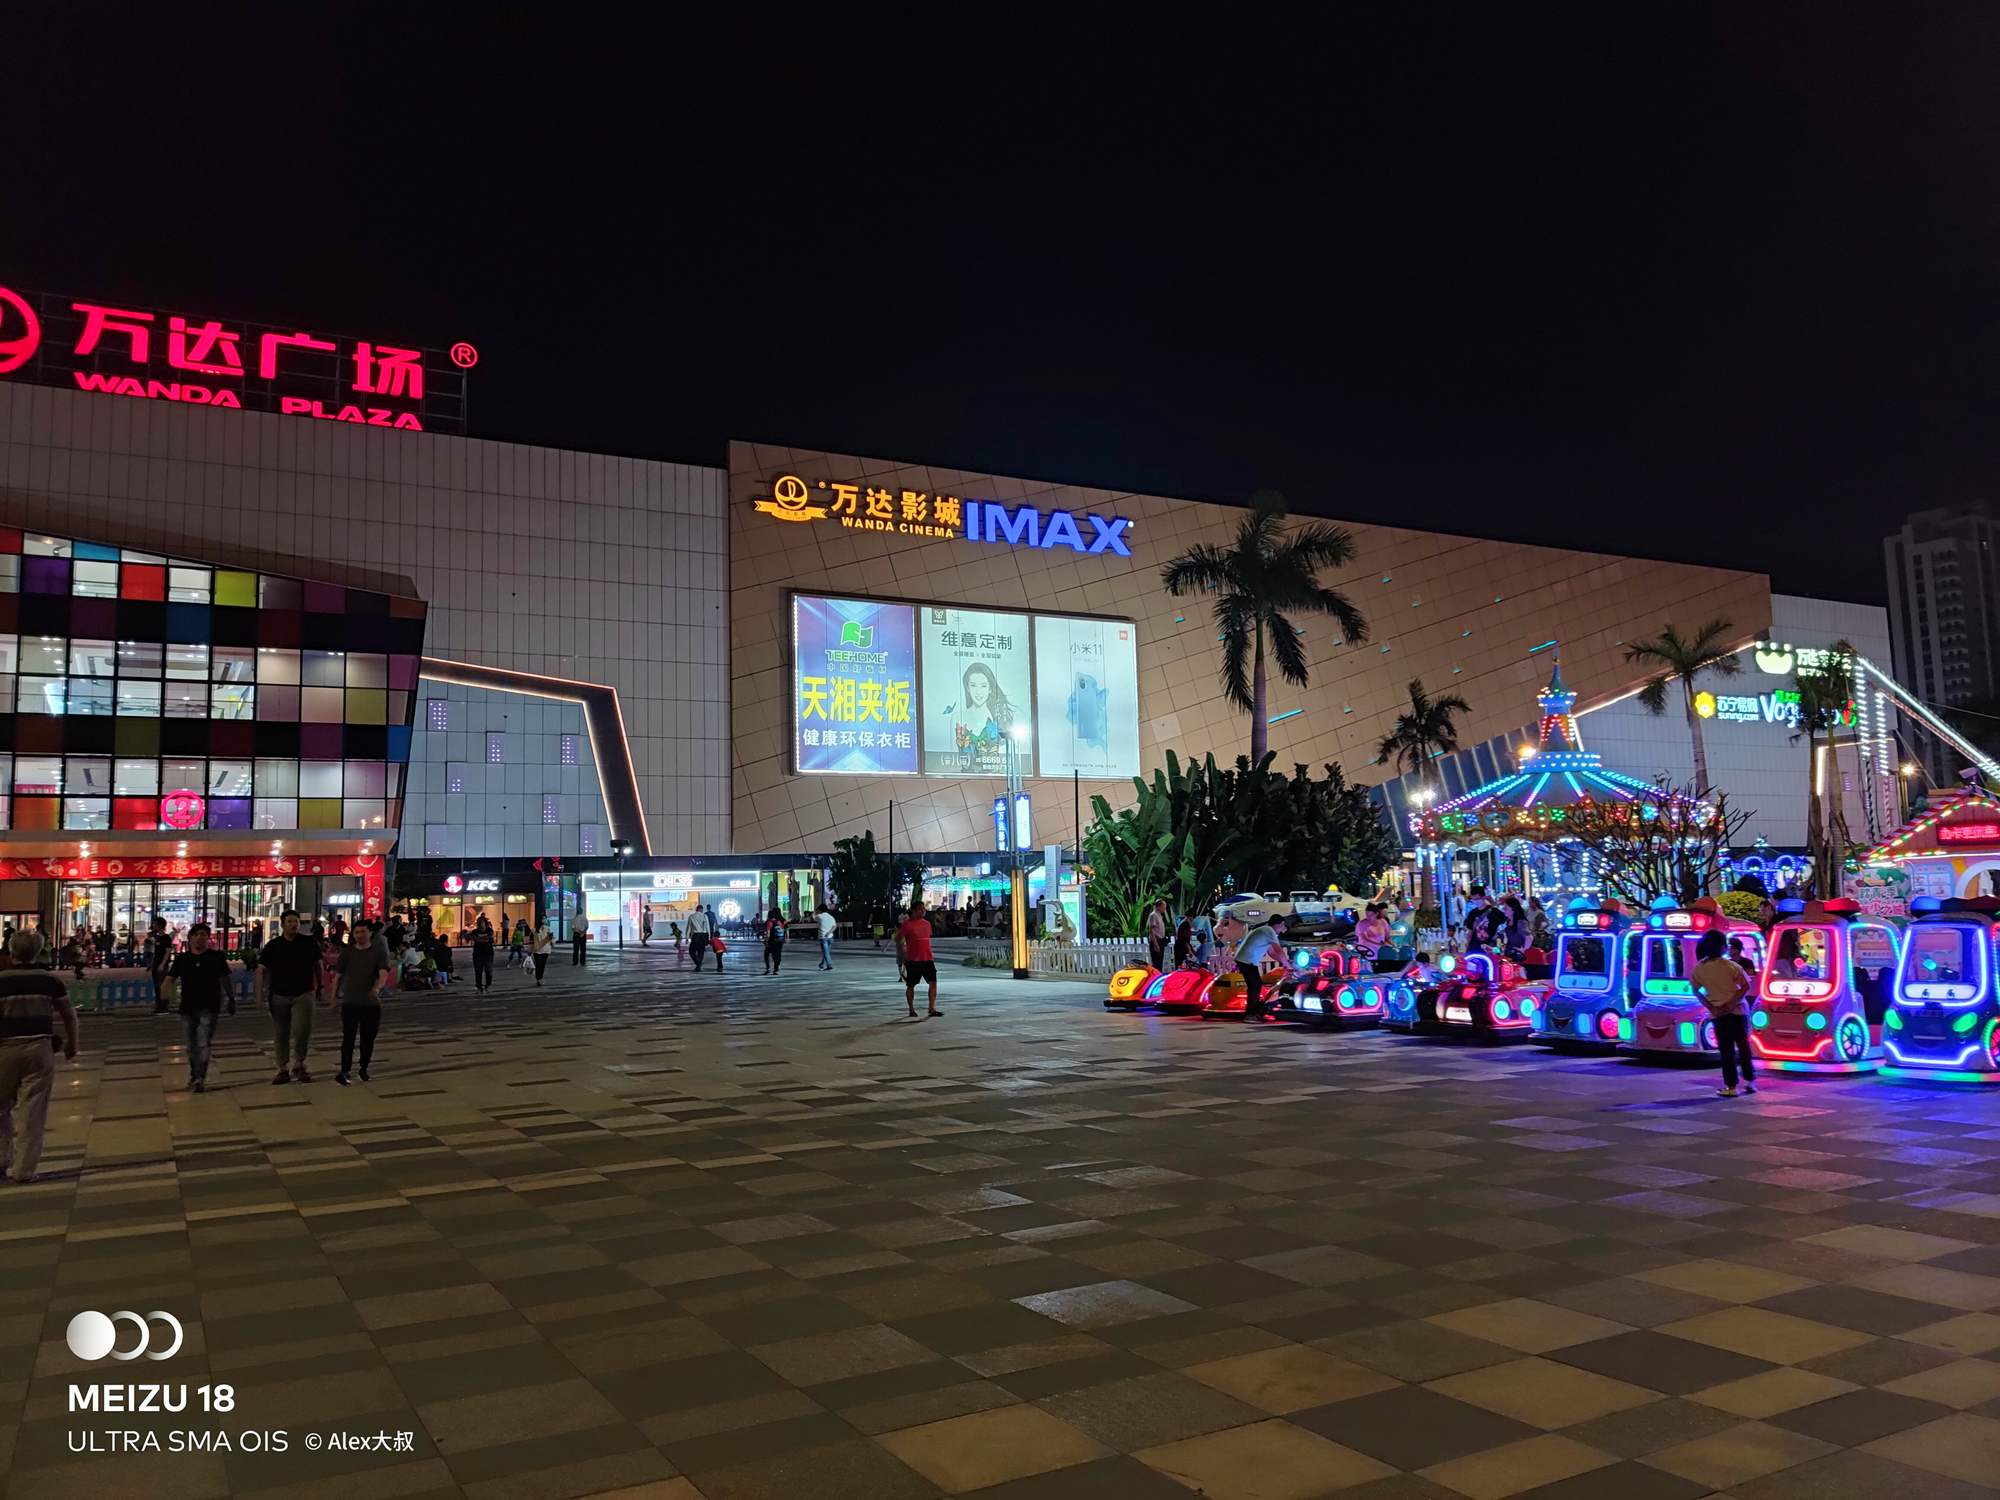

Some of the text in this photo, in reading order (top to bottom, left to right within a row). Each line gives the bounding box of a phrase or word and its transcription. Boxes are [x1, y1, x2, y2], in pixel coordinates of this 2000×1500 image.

[72, 302, 424, 400] 万达广场
[74, 371, 424, 431] WANDA PLAZA
[831, 482, 961, 528] 万达影城
[841, 516, 955, 539] WANDA CINEMA
[966, 501, 1132, 556] IMAX
[941, 630, 1012, 650] 维意定制
[1069, 641, 1102, 655] 小米11
[802, 676, 911, 724] 天湘夹板
[1716, 696, 1758, 713] 苏宁易购
[1718, 711, 1759, 723] suning.com
[803, 728, 912, 749] 健康环保衣柜
[466, 880, 499, 891] KFC
